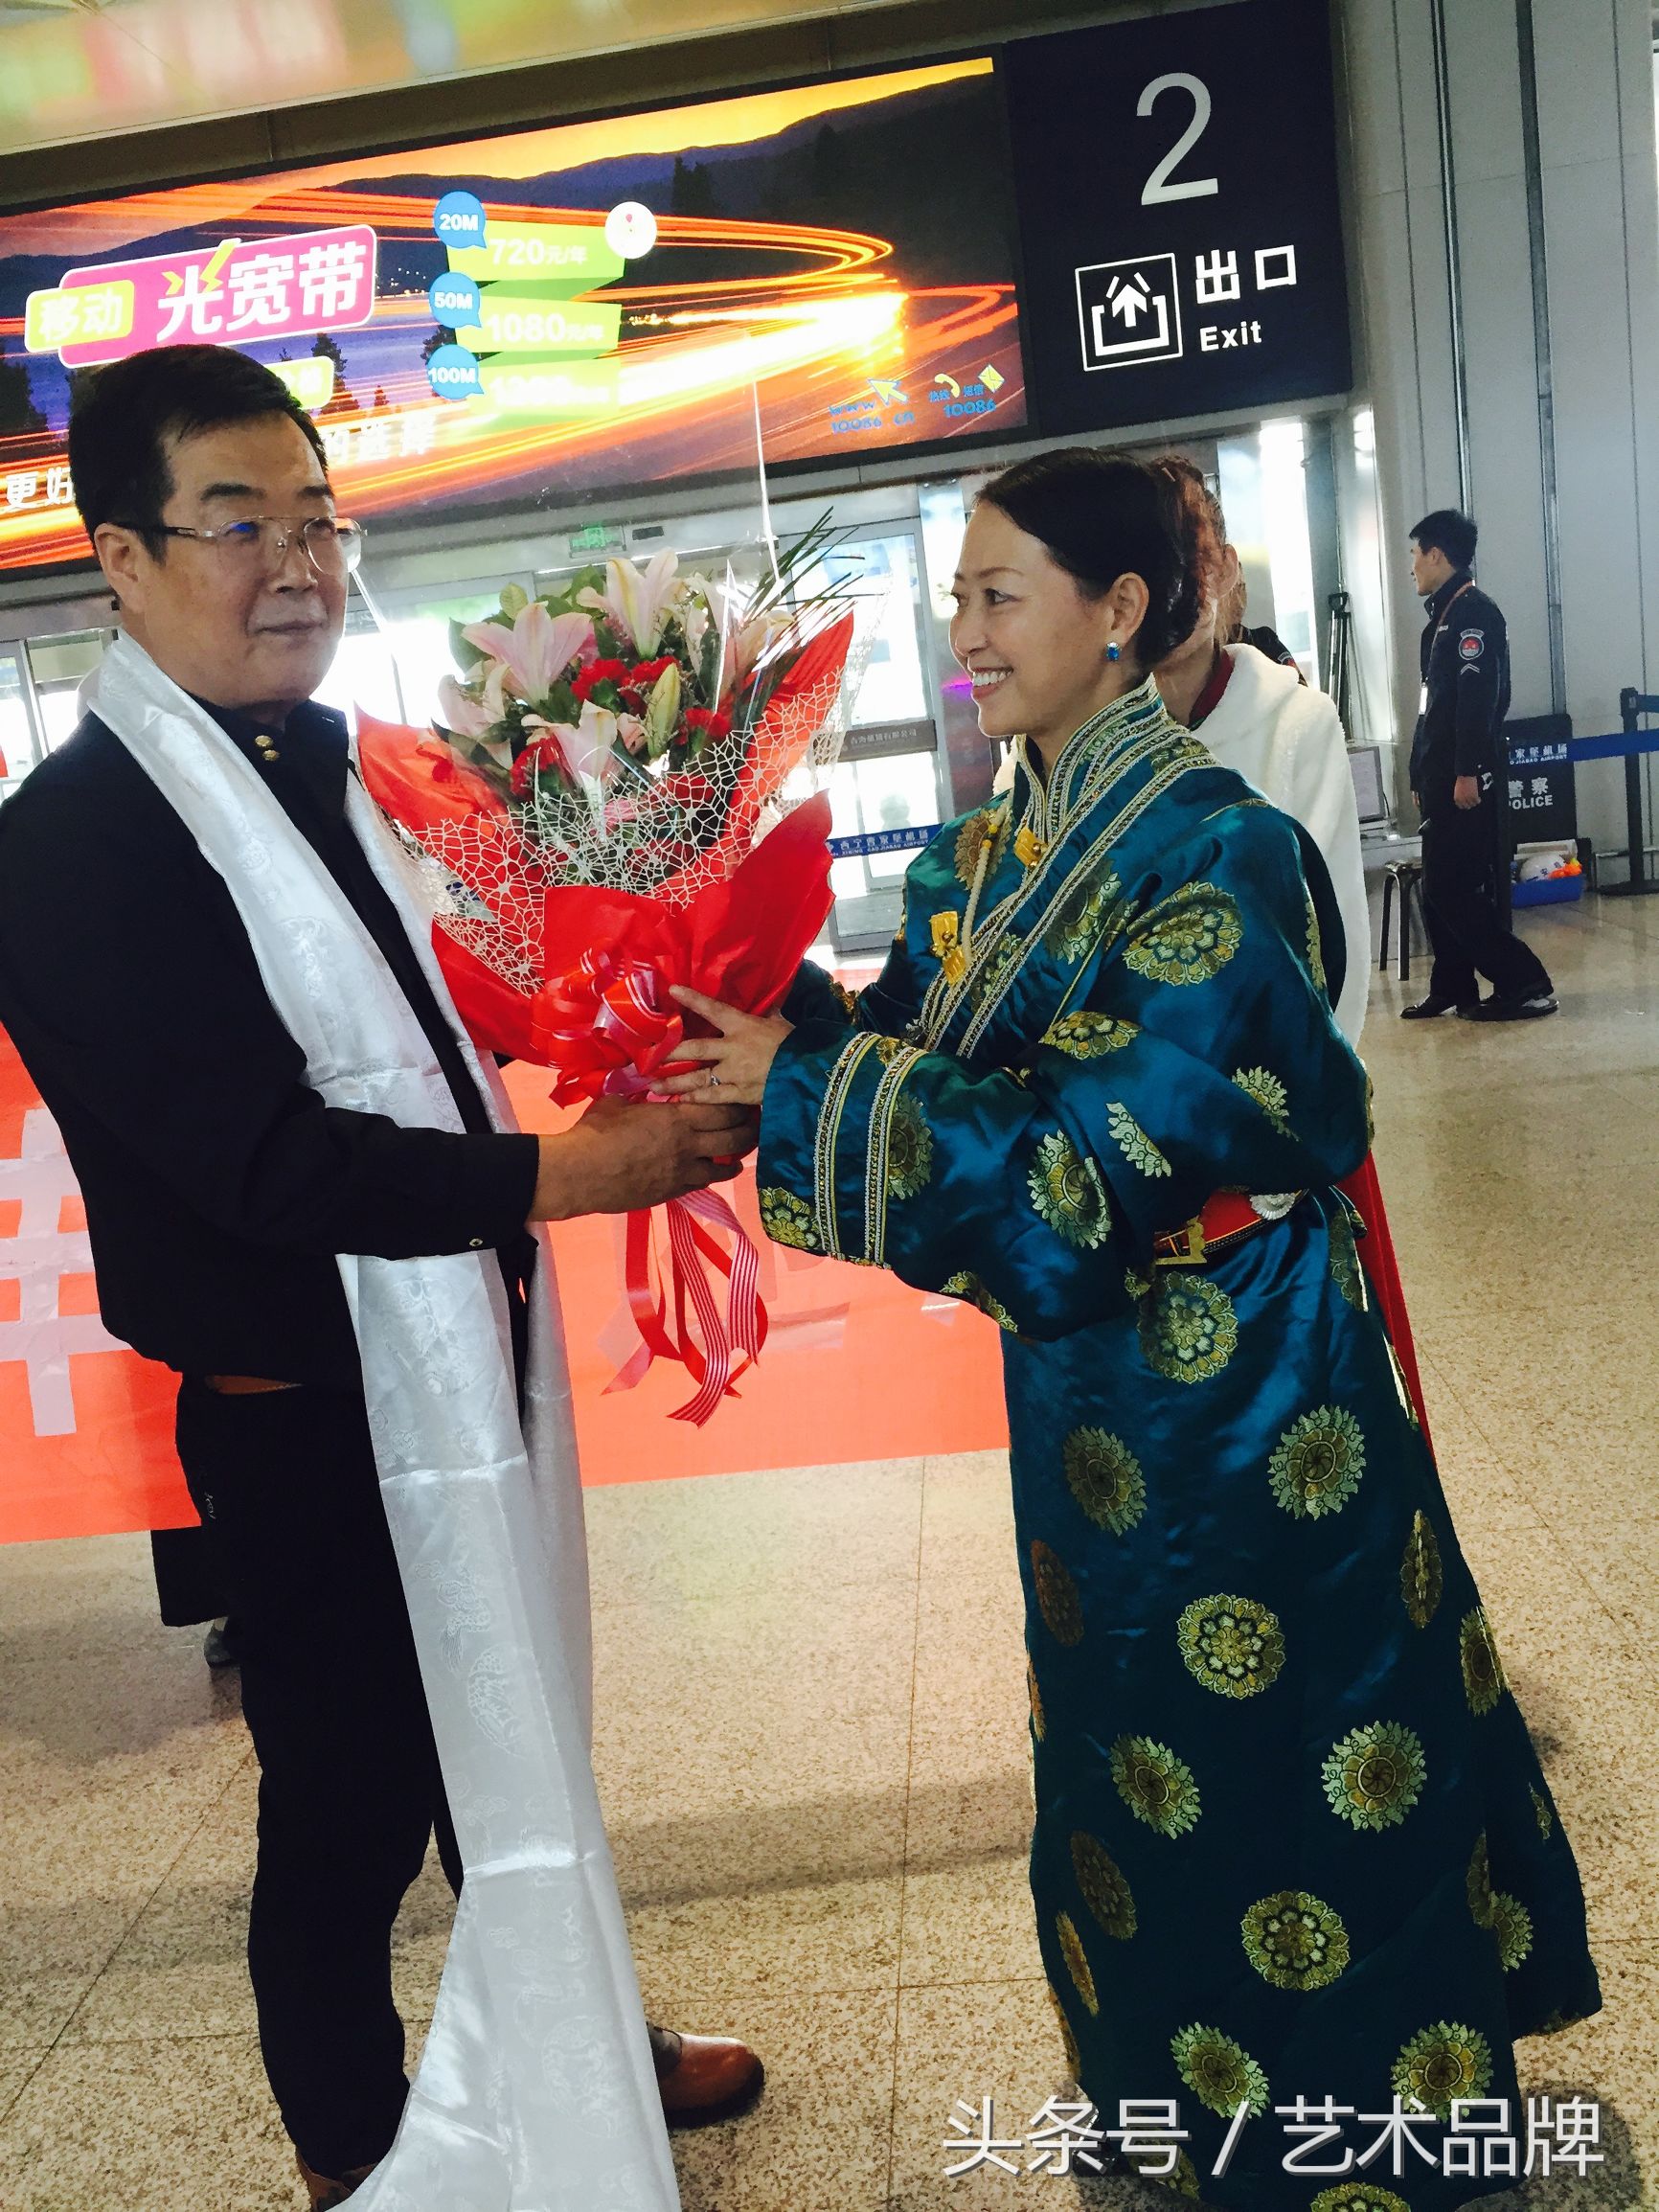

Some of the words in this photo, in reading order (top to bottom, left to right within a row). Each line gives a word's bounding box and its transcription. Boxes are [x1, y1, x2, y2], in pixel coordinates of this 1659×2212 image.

[1136, 72, 1218, 205] 2
[439, 213, 479, 232] 20M
[1195, 244, 1297, 305] 出口
[39, 290, 124, 341] 移动
[157, 240, 367, 342] 光宽带
[434, 291, 473, 310] 50M
[1199, 320, 1262, 352] Exit
[427, 368, 476, 384] 100M
[943, 399, 996, 419] 10086
[1508, 777, 1549, 799] 警察
[1508, 794, 1554, 810] OLICE
